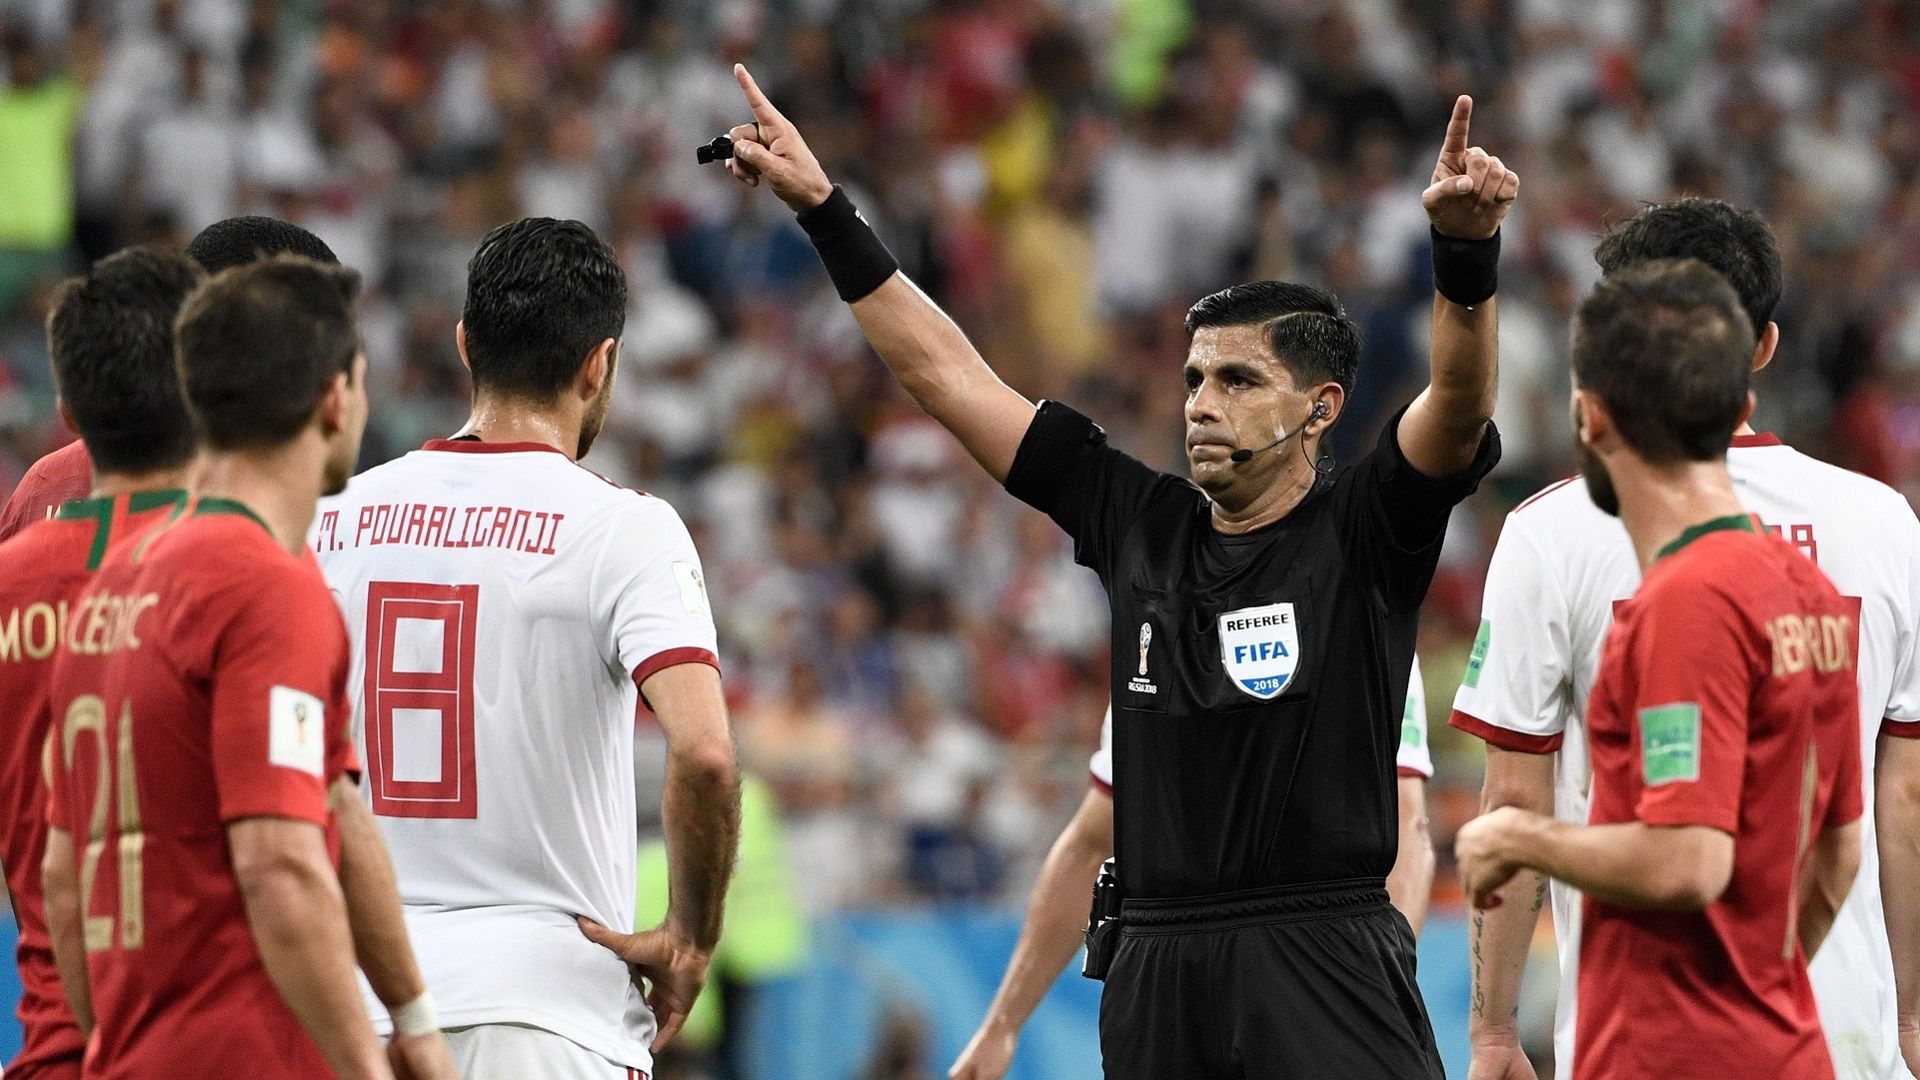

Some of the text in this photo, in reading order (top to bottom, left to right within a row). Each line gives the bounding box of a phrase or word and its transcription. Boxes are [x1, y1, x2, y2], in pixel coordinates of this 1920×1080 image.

[317, 503, 565, 555] M. POURALIGANJI
[1227, 613, 1290, 632] REFEREE
[1234, 641, 1289, 665] FIFA
[365, 580, 480, 820] 8
[1253, 678, 1280, 692] 2018
[63, 693, 146, 950] 21
